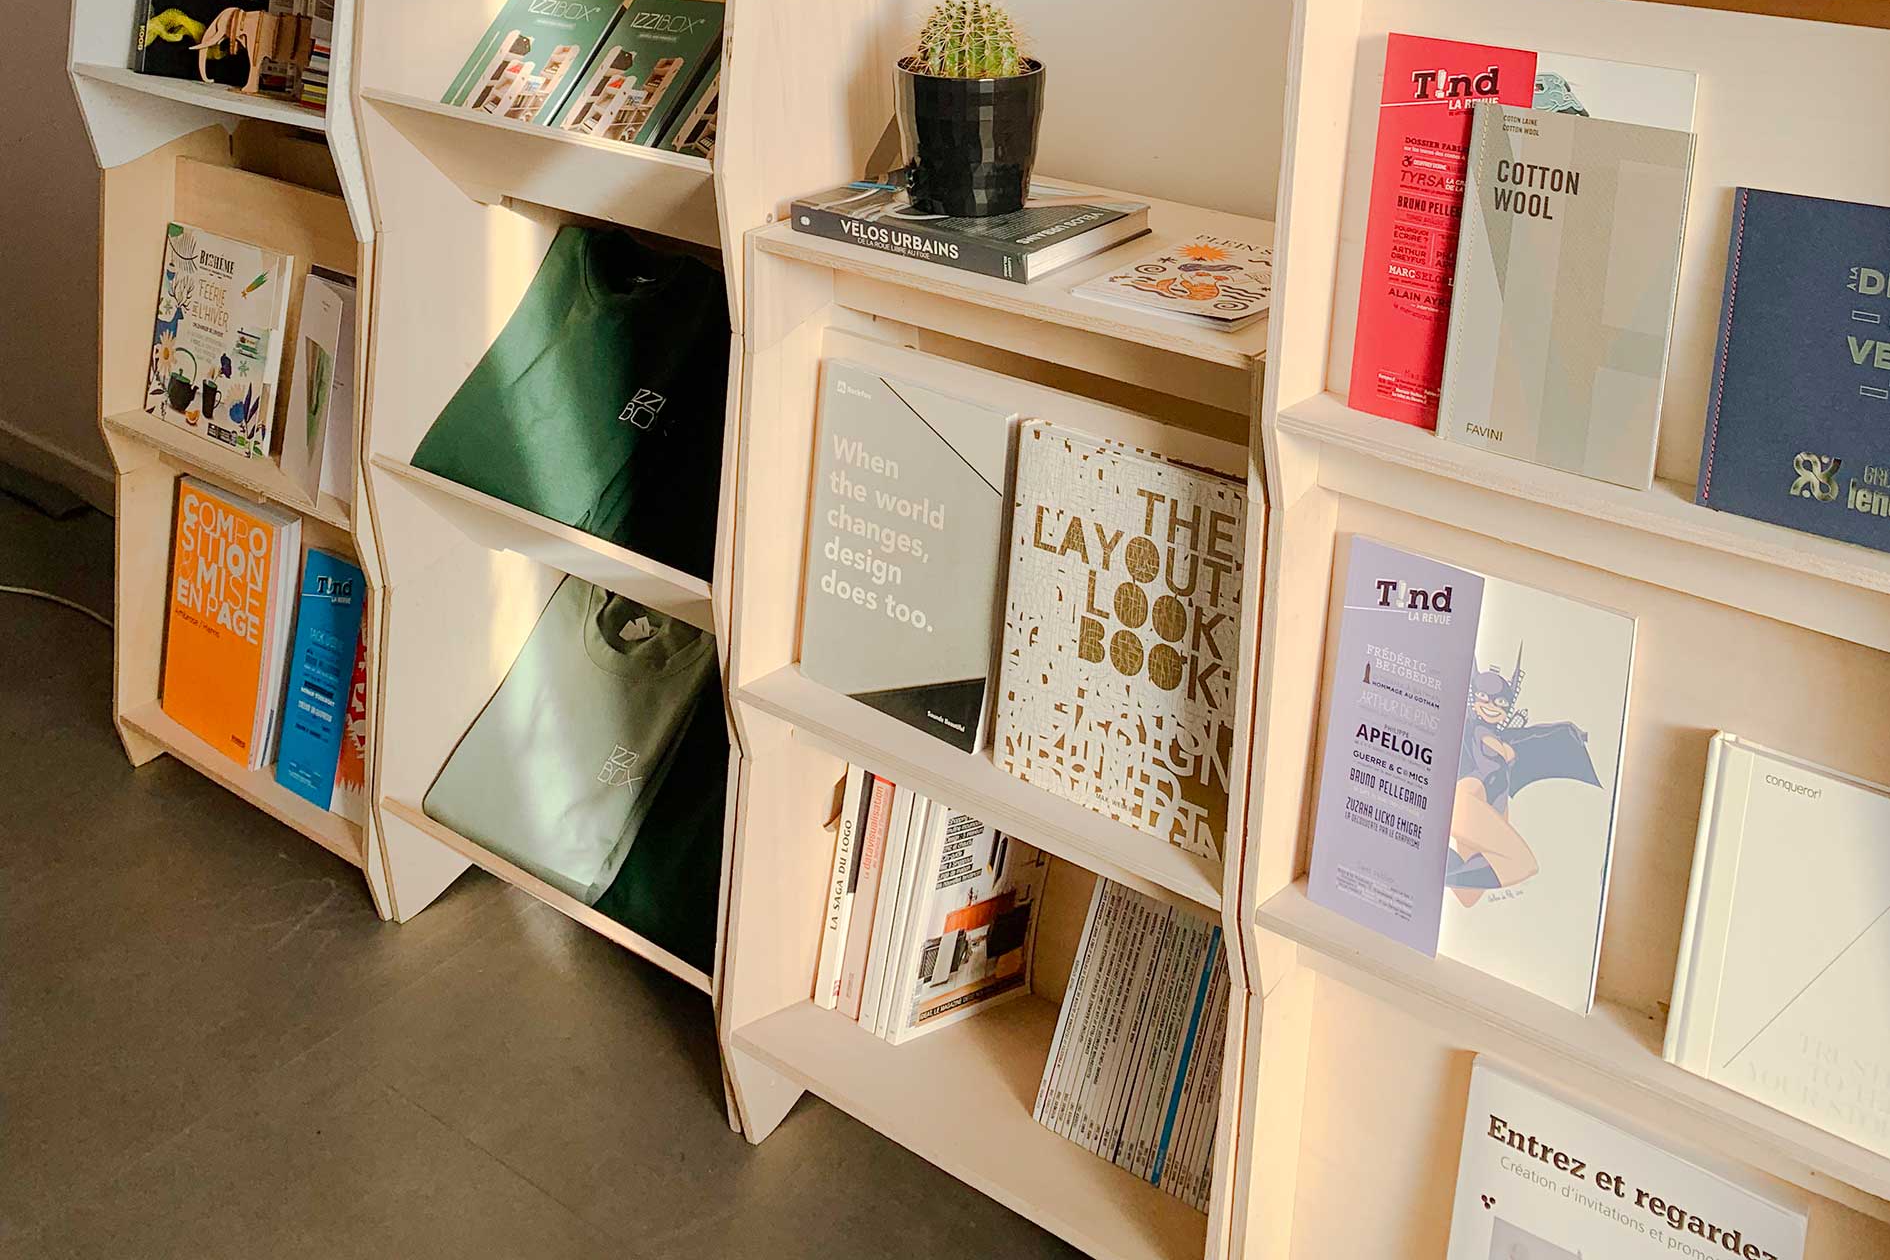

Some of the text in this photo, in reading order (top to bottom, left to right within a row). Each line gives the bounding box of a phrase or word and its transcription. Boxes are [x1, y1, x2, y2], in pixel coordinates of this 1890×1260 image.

[137, 24, 146, 51] BOOK
[1448, 98, 1462, 110] LA
[1405, 136, 1440, 149] DOSSIER
[1502, 124, 1540, 137] COTTON WOOL
[1401, 169, 1446, 189] TYRSA
[1497, 159, 1580, 196] COTTON
[1397, 195, 1427, 212] BRUNO
[1494, 186, 1553, 220] WOOL
[891, 231, 960, 260] URBAINS
[1390, 251, 1426, 266] DREYFUS
[1392, 245, 1427, 258] ARTHUR
[1388, 287, 1421, 302] ALAIN
[1465, 422, 1504, 442] FAVINI
[832, 434, 899, 480] When
[828, 470, 945, 532] the world
[827, 507, 930, 564] changes,
[1136, 488, 1237, 563] THE
[824, 537, 902, 586] design
[1032, 503, 1233, 609] LAYOUT
[177, 576, 203, 613] EN
[206, 593, 261, 645] PAGE
[821, 569, 935, 633] does too.
[1086, 568, 1229, 662] LOOK
[1408, 611, 1452, 626] LA REVUE
[1078, 615, 1221, 710] BOOK
[1367, 643, 1427, 674] FRÉDÉRIC
[1375, 658, 1442, 691] BEIGBEDER
[1371, 680, 1440, 709] HOMMAGE AU GOTHAM
[1353, 750, 1387, 769] GUERRE
[1388, 764, 1394, 772] &
[1356, 723, 1433, 765] APELOIG
[1349, 767, 1428, 811] BRUNO PELLEGRINO
[864, 786, 885, 871] datavisualisation
[1345, 796, 1374, 819] ZUZANA
[1375, 808, 1396, 828] LICKO
[830, 820, 853, 931] LA SAGA DU LOGO
[1487, 1114, 1587, 1181] Entrez
[1595, 1166, 1625, 1199] et
[1500, 1156, 1558, 1193] Création
[1561, 1182, 1645, 1235] d'invitations
[1648, 1226, 1664, 1244] et
